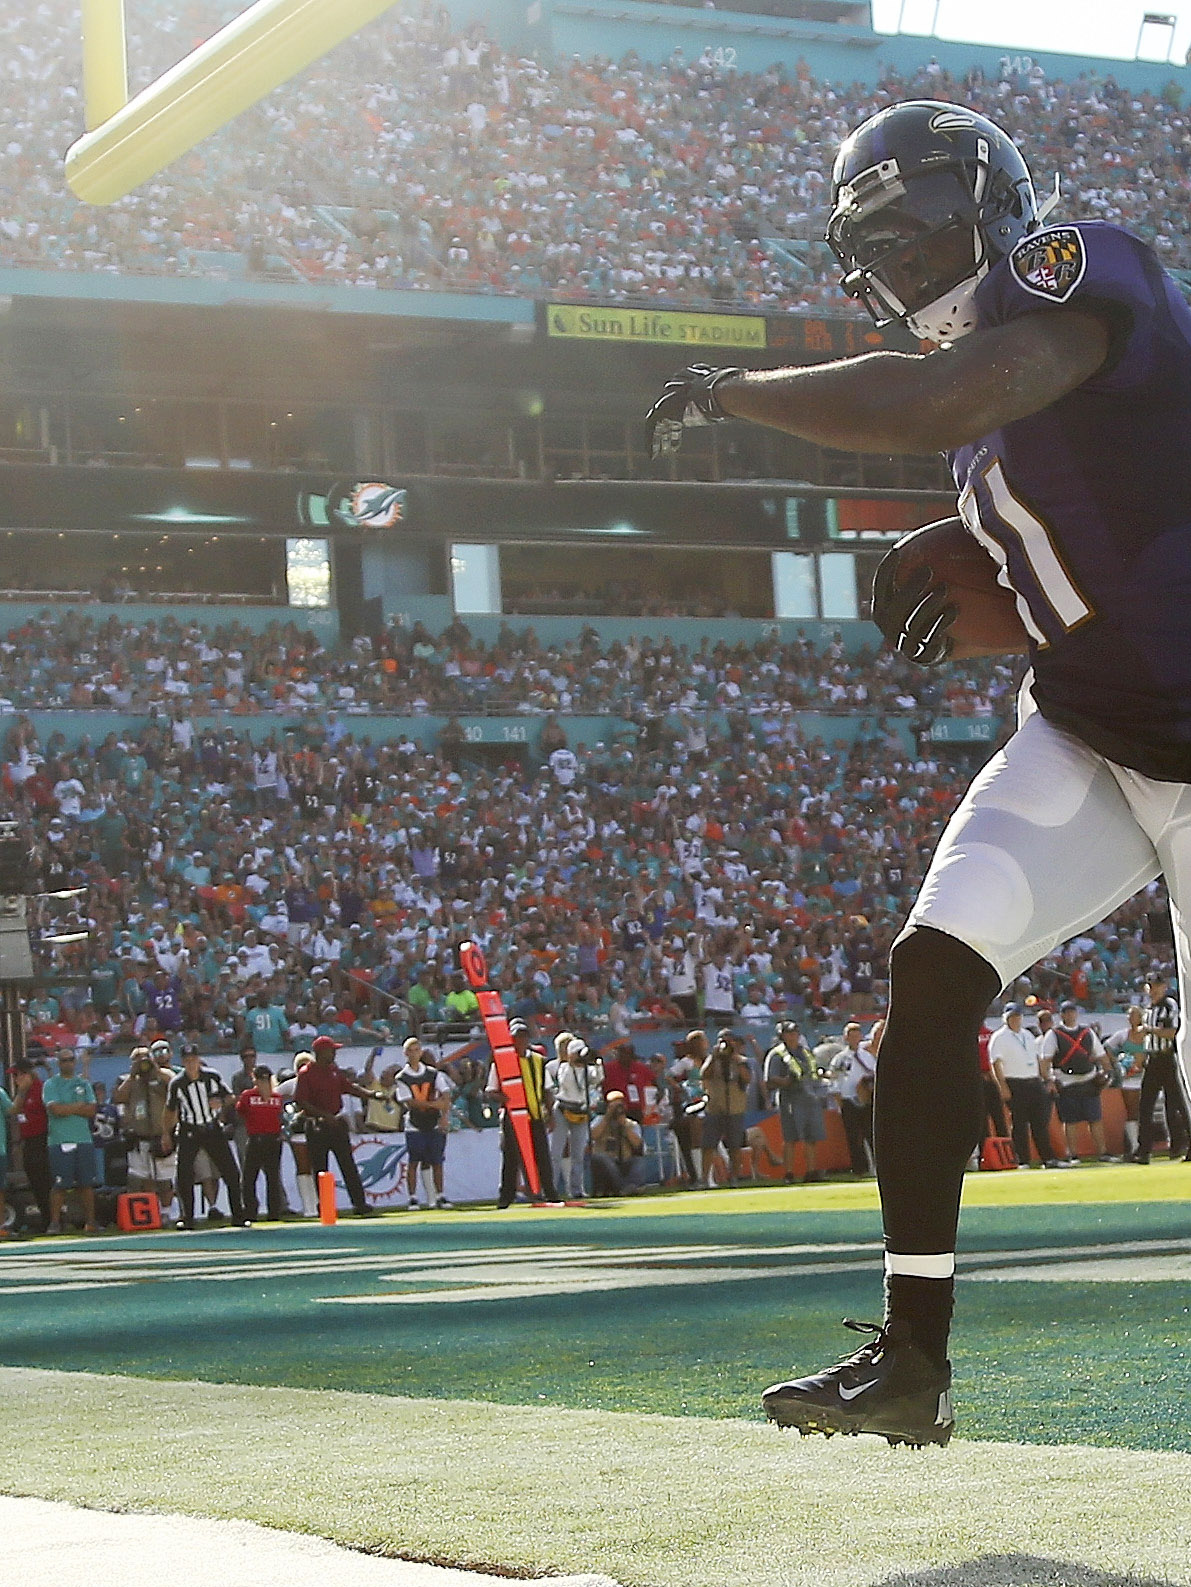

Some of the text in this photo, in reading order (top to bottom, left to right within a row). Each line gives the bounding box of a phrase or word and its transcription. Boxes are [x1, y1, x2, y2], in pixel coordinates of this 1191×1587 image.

[1017, 232, 1071, 258] RAVENS
[579, 312, 623, 335] Sun
[630, 312, 672, 338] Life
[679, 323, 761, 343] STADIUM
[155, 995, 173, 1010] 52
[255, 1013, 271, 1030] 91
[129, 1197, 151, 1227] G
